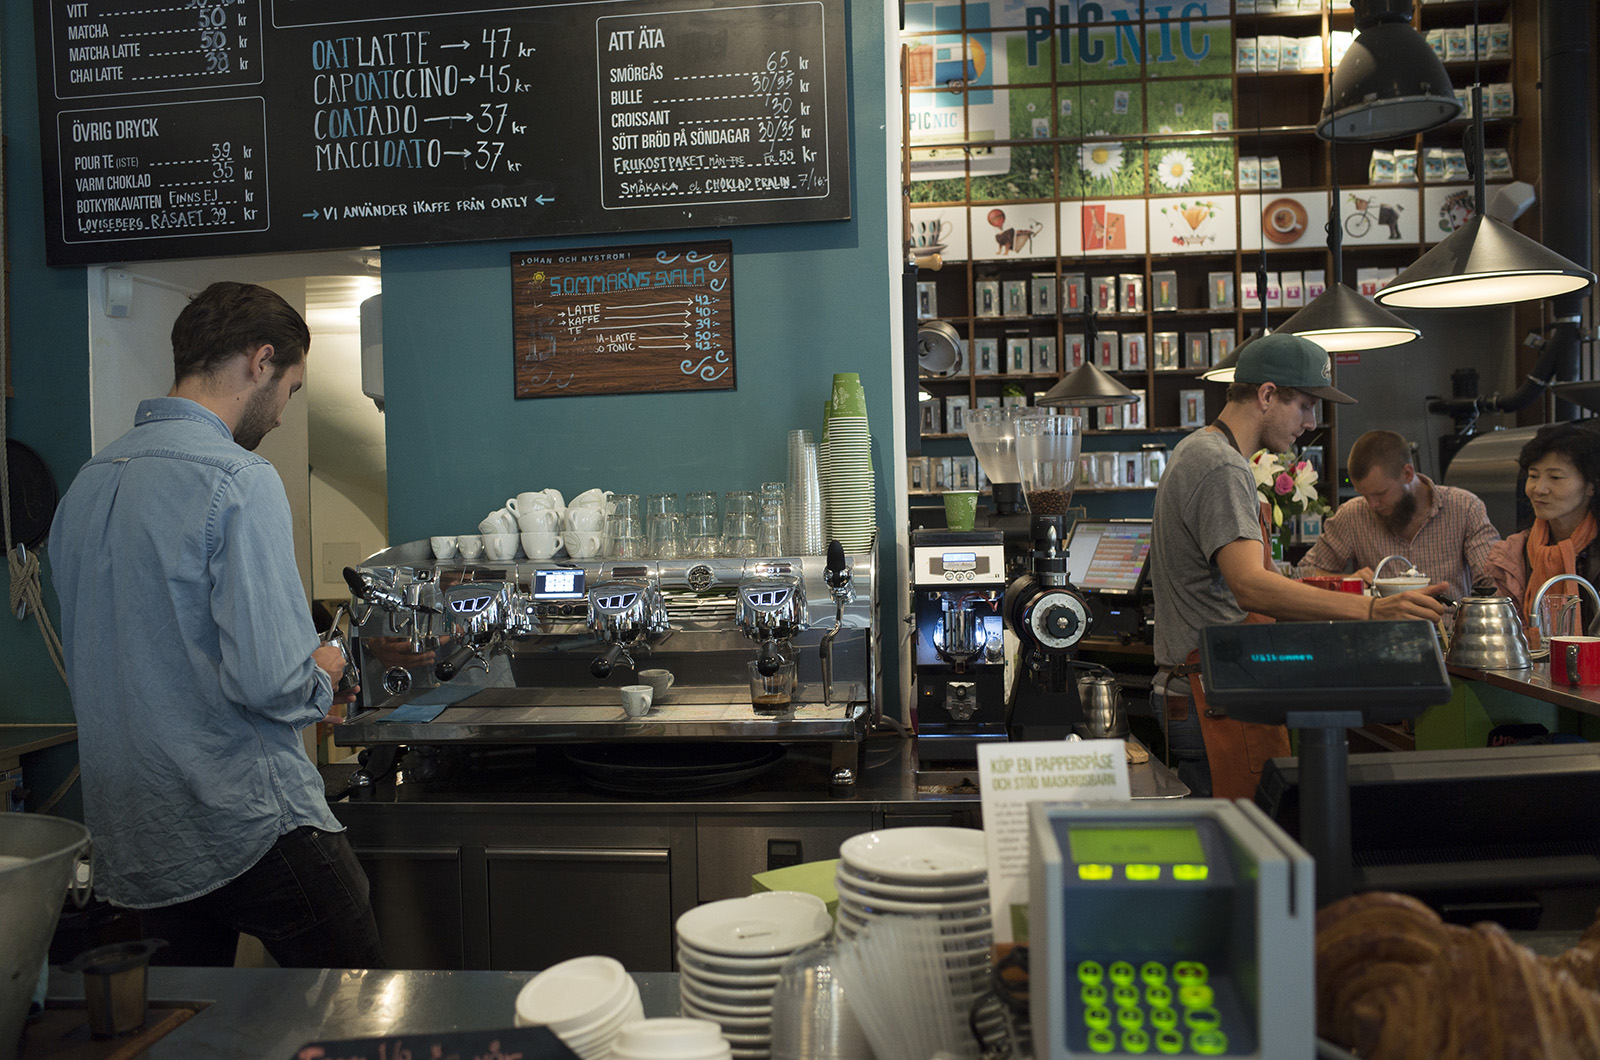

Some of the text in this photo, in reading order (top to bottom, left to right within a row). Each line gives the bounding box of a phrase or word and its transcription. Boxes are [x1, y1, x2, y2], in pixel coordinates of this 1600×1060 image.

[67, 3, 88, 18] VITT
[68, 7, 246, 40] MATCHA 50 kr
[69, 30, 248, 62] MATCHA LATTE 50 kr
[482, 28, 512, 58] 47
[518, 42, 536, 57] kr
[608, 25, 666, 52] ATT ÄTA
[1025, 2, 1211, 67] PICNIC
[70, 52, 248, 84] CHAI LATTE 38 kr
[610, 50, 809, 83] SMÖRGÅS 65 kr
[314, 64, 532, 104] CAPOATCCINO 45 kr
[610, 88, 643, 106] BULLE
[800, 79, 810, 92] kr
[314, 103, 528, 140] COATADO 37 kr
[611, 97, 811, 128] CROISSANT 30 kr
[909, 112, 958, 130] PICNIC
[72, 118, 160, 142] ÖVRIG DRYCK
[612, 131, 639, 150] SÖTT
[642, 130, 671, 149] BRÖD
[673, 128, 688, 147] PÅ
[690, 128, 750, 146] SÖNDAGAR
[801, 124, 811, 138] kr
[74, 142, 252, 170] POUR TE (ISTE) 39 kr
[315, 138, 522, 172] MACCIOATO 37 kr
[76, 160, 253, 192] VARM CHOKLAD 35 kr
[754, 176, 790, 188] PRALIN
[76, 189, 254, 214] BOTKYRKAVATTEN FINNS EJ kr
[323, 206, 338, 220] VI
[343, 202, 408, 218] ANVÄNDER
[456, 196, 486, 211] FRÅN
[491, 196, 528, 209] OATLY
[150, 210, 203, 228] RÅSAFT
[210, 207, 226, 223] 39
[244, 206, 258, 220] kr
[520, 257, 552, 266] JOHAN
[654, 267, 705, 286] SVALA
[568, 304, 601, 317] LATTE
[568, 315, 600, 327] KAFFE
[568, 326, 584, 335] TE
[606, 342, 636, 352] TONIC
[990, 751, 1114, 774] KÖP EN PAPPERSPÅSE
